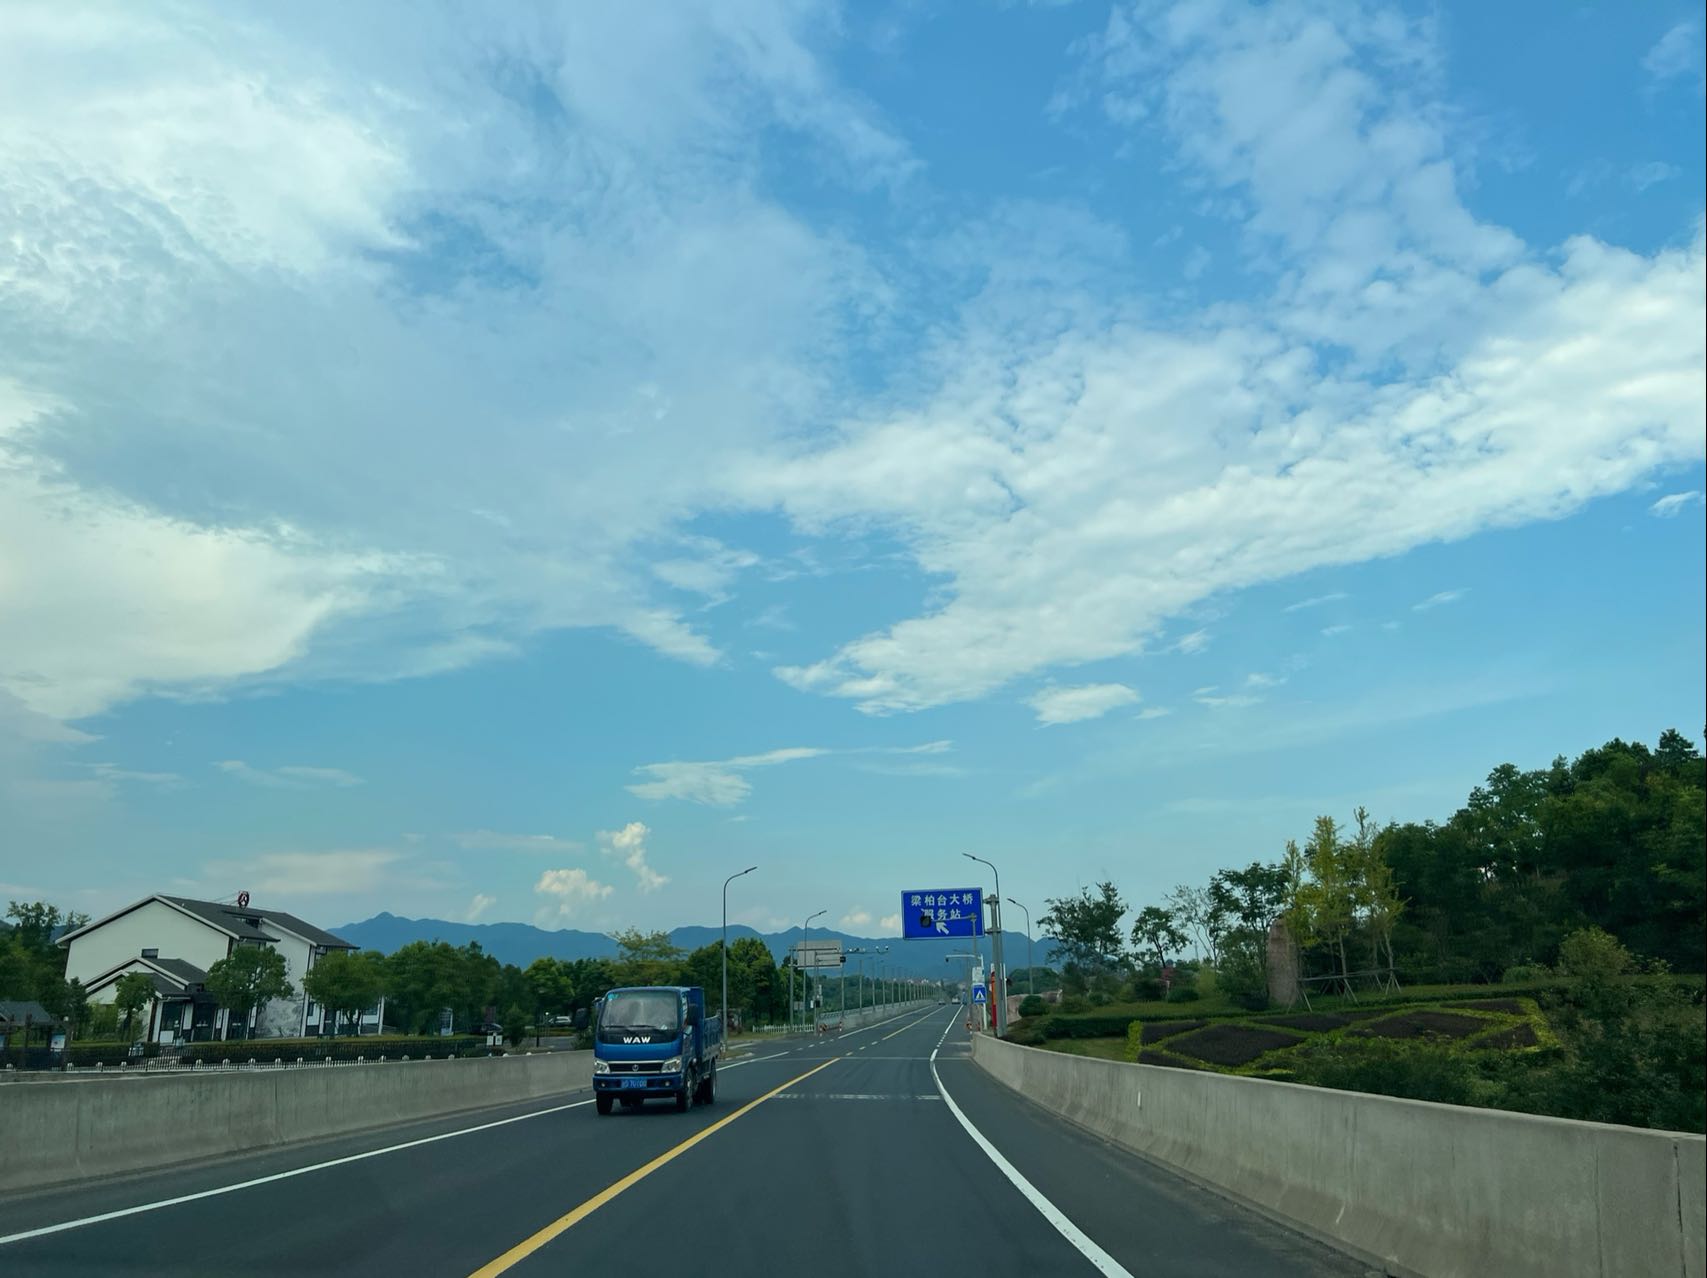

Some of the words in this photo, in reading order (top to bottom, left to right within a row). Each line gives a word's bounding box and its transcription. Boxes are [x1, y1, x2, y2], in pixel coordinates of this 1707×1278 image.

[911, 893, 973, 907] 梁柏台大桥
[623, 1036, 651, 1044] WAW
